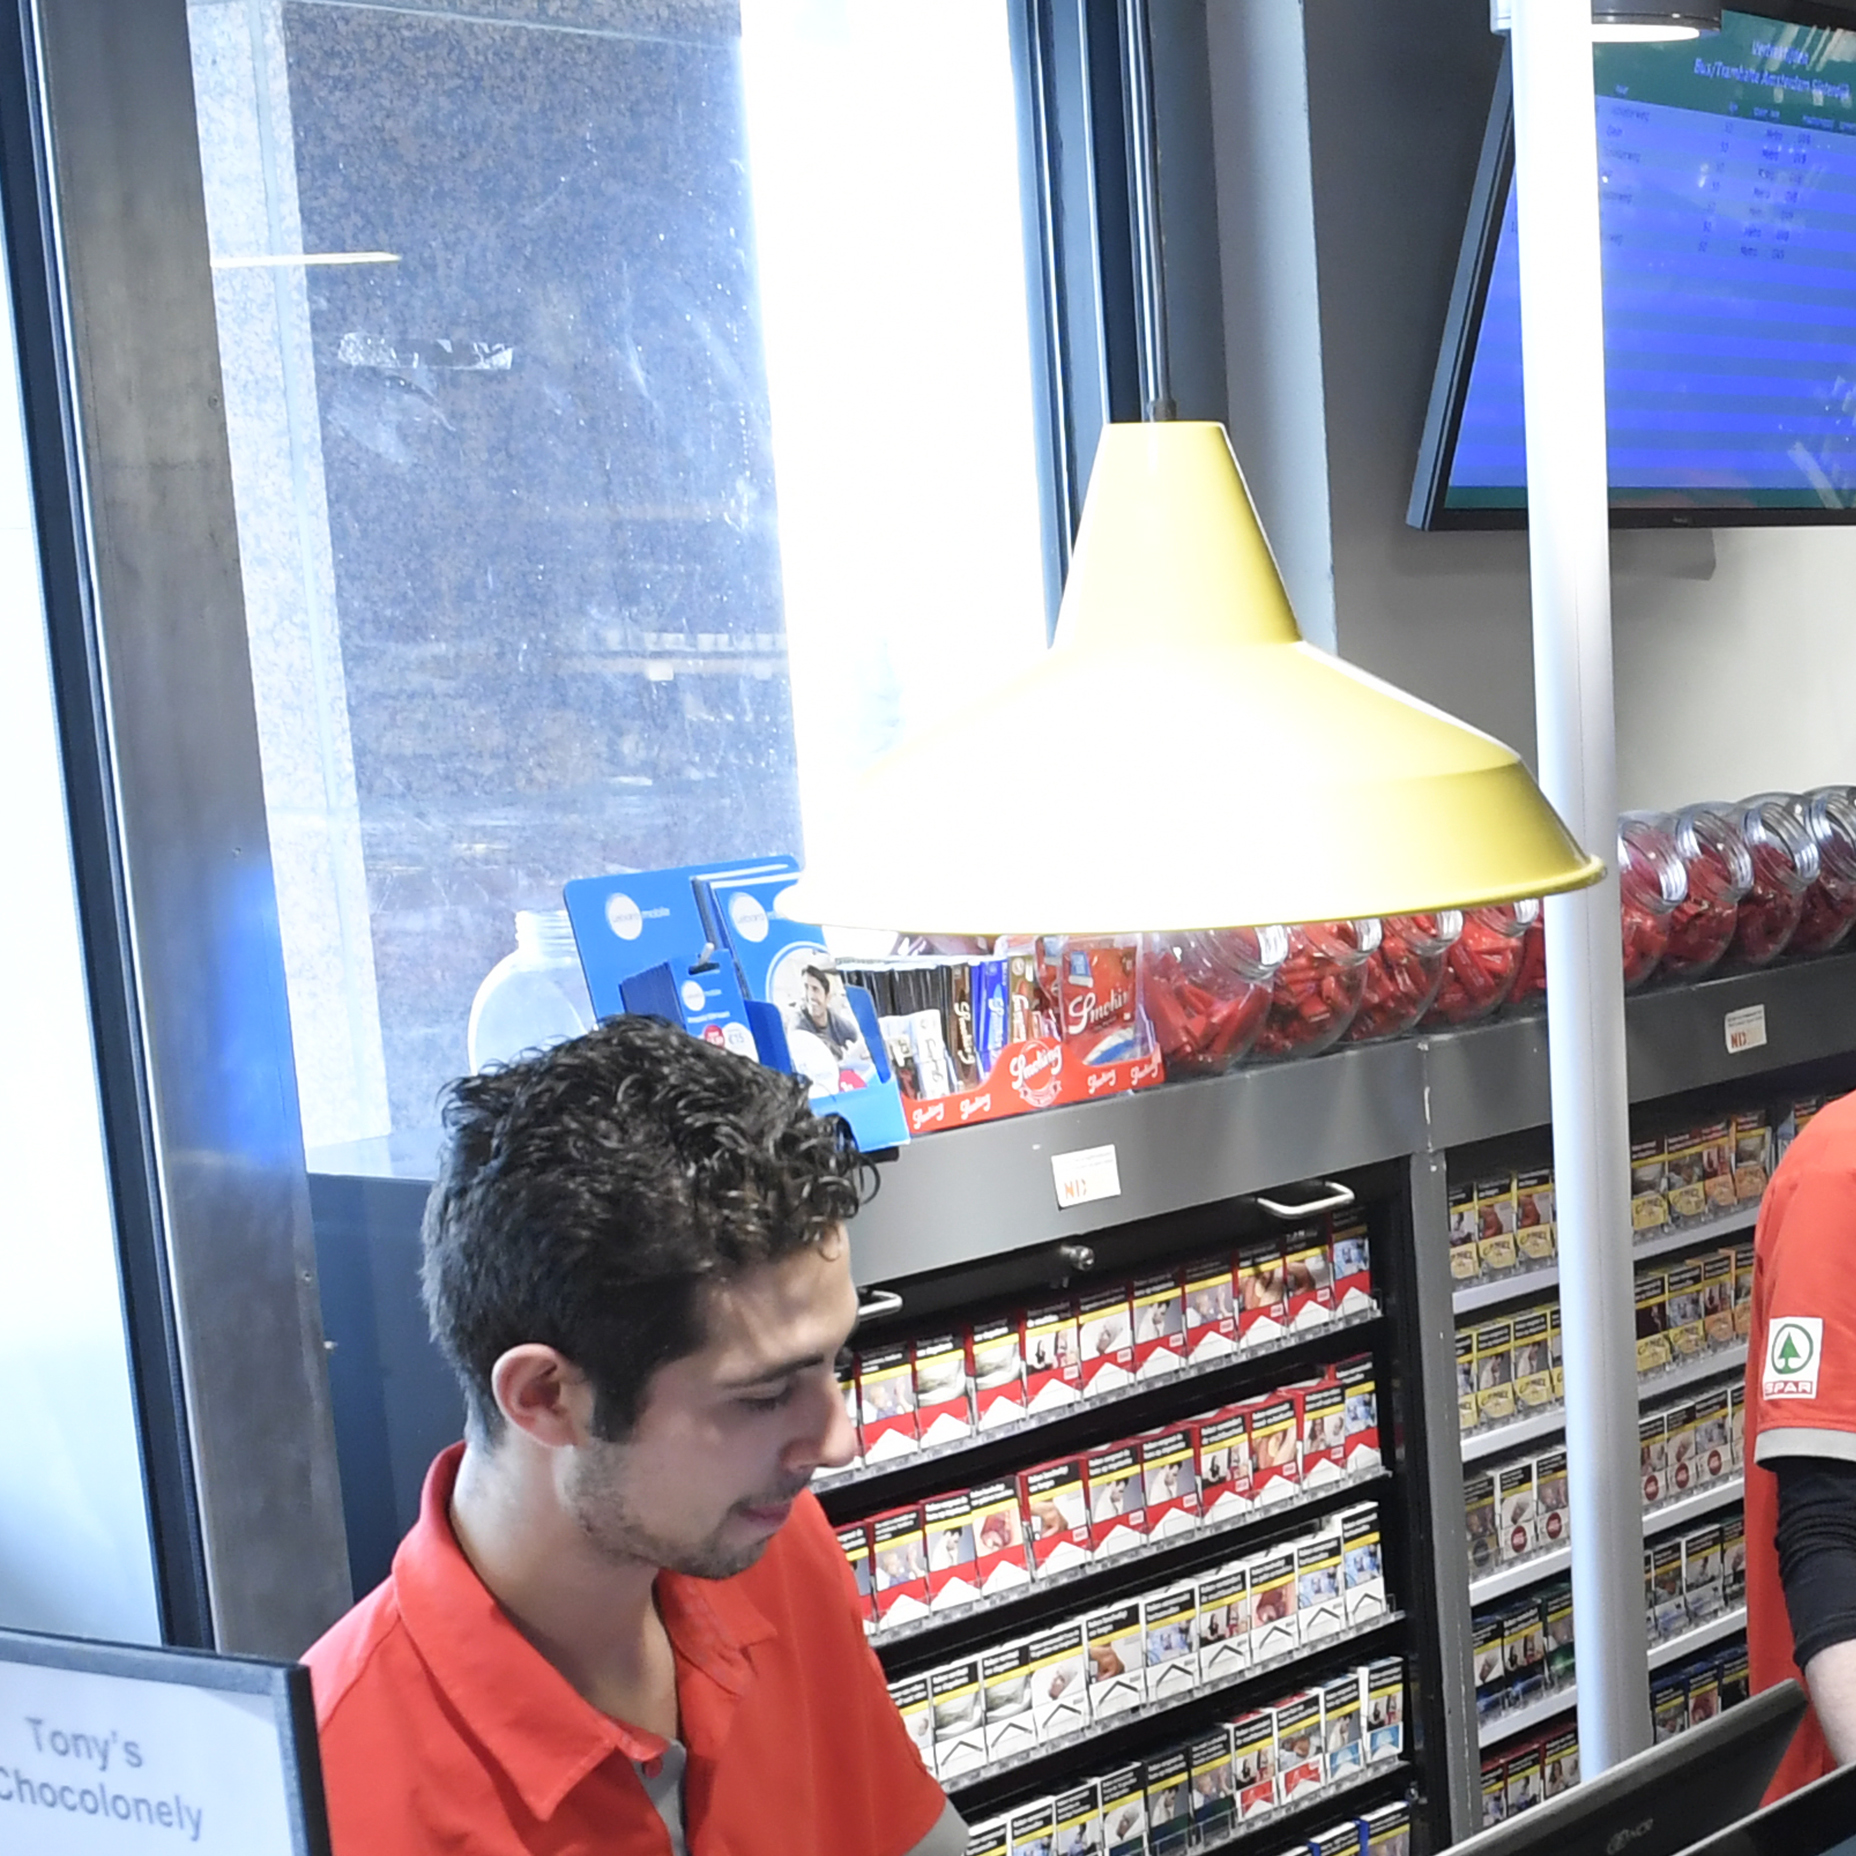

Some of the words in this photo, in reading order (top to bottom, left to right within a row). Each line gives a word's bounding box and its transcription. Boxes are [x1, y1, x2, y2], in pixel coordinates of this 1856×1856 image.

[1009, 1044, 1063, 1090] Smoking
[1765, 1381, 1813, 1396] SPAR
[25, 1717, 143, 1771] Tony's
